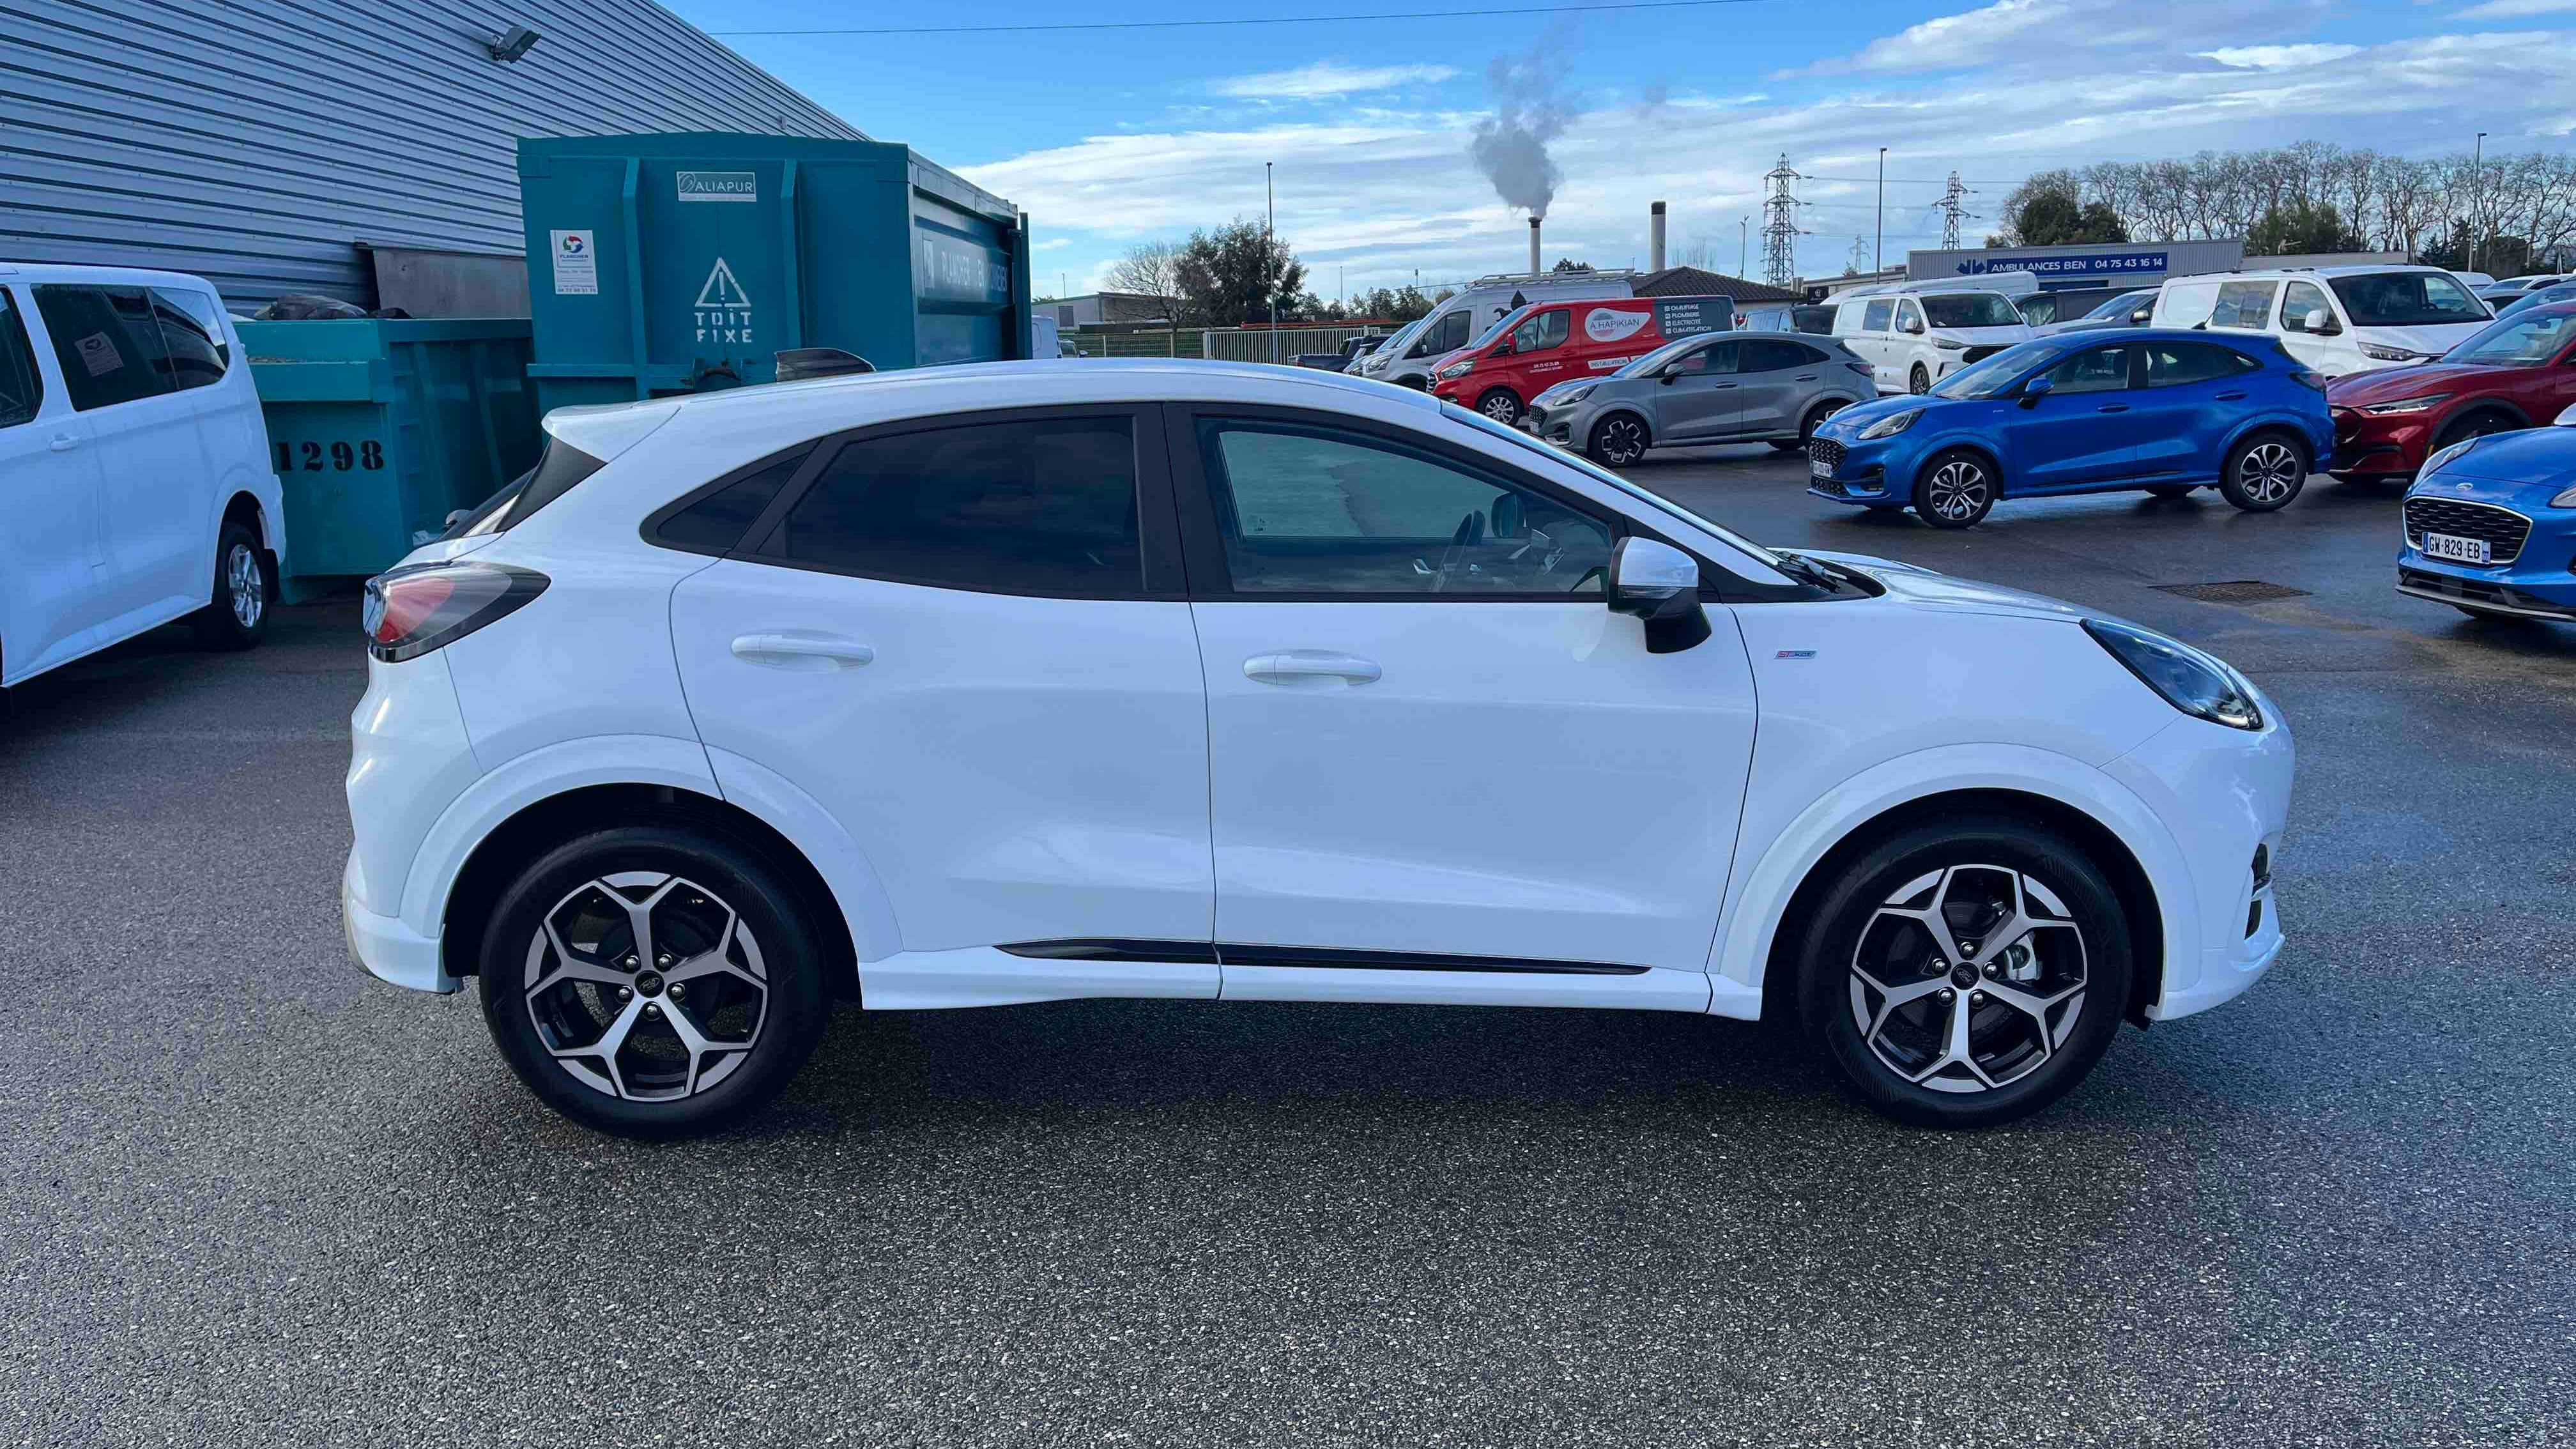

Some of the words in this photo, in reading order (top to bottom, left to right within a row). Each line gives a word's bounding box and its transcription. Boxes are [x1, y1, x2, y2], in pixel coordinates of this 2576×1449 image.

[695, 181, 753, 192] ALIAPUR
[1991, 262, 2060, 272] AMBULANCES
[2064, 261, 2087, 270] BEN
[2095, 259, 2108, 268] 04
[2110, 259, 2122, 268] 75
[2124, 258, 2137, 267] 43
[2140, 258, 2150, 266] 16
[2153, 257, 2163, 266] 14
[696, 328, 752, 343] FIXE
[276, 440, 384, 471] 1298
[2429, 536, 2480, 559] GW-829-EB
